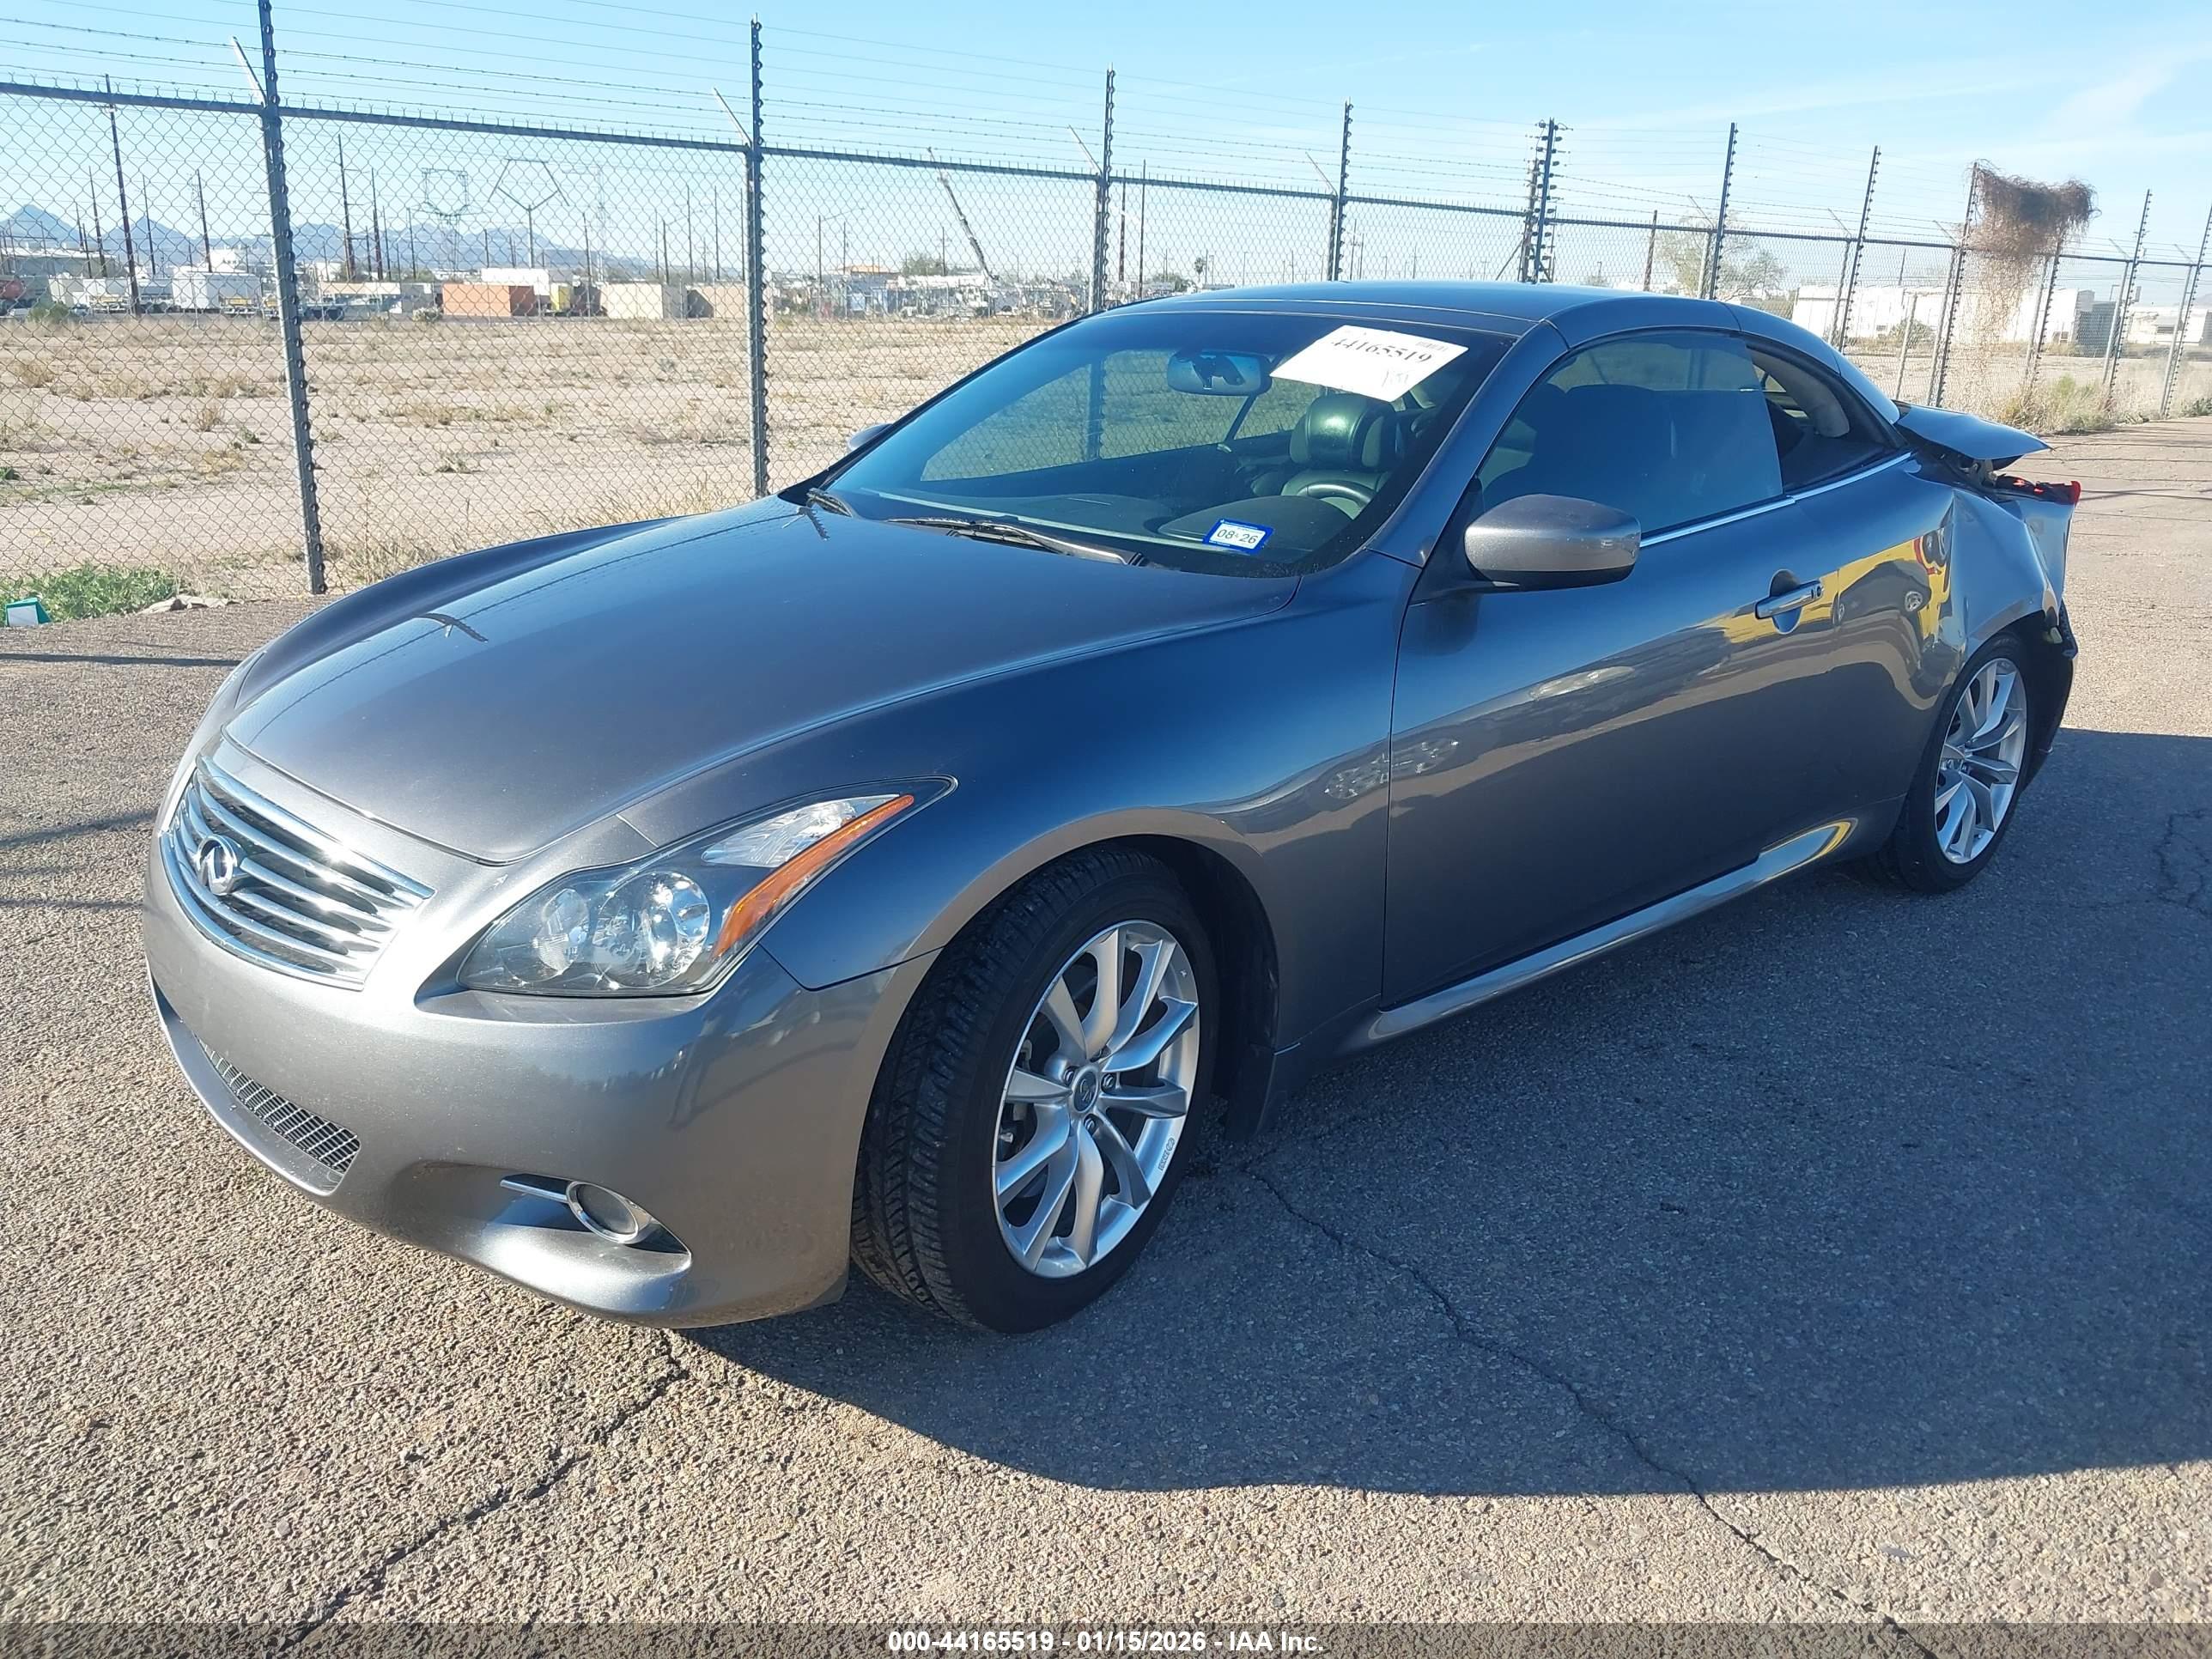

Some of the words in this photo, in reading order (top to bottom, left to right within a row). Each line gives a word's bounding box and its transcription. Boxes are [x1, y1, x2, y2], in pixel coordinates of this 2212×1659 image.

[1330, 337, 1433, 363] 44165519
[1216, 528, 1236, 540] 08
[1238, 532, 1260, 544] 26
